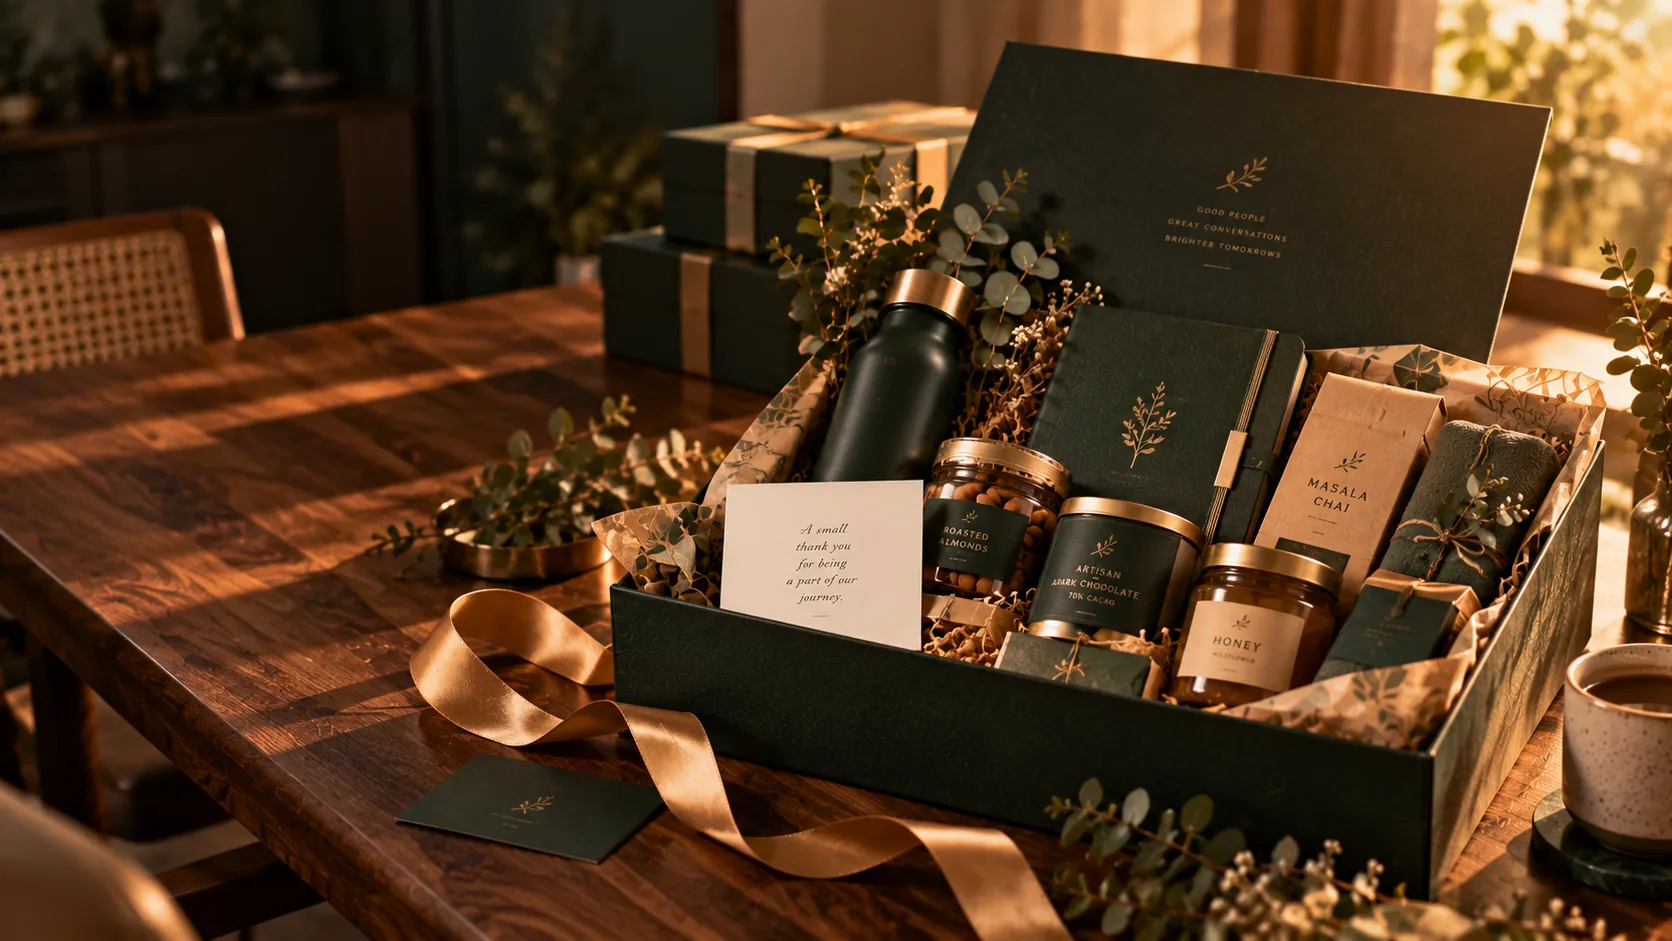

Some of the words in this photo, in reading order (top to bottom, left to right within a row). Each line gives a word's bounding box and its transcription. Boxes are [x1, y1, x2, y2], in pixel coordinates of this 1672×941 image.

[1197, 206, 1225, 216] GOOD
[1228, 211, 1266, 223] PEOPLE
[1167, 218, 1200, 229] GREAT
[1203, 223, 1288, 243] CONVERSATIONS
[1164, 234, 1215, 249] BRIGHTER
[1307, 477, 1368, 502] MASALA
[1313, 496, 1350, 513] CHAI
[800, 523, 814, 535] A
[815, 523, 849, 535] small
[943, 526, 989, 541] ROASTED
[795, 540, 828, 551] thank
[829, 543, 851, 554] you
[938, 537, 989, 553] ALMONDS
[795, 557, 815, 572] for
[817, 558, 848, 571] being
[1075, 565, 1121, 580] ARTISAN
[795, 577, 822, 588] part
[824, 574, 838, 587] of
[796, 592, 843, 605] journey.
[1212, 636, 1262, 653] HONEY
